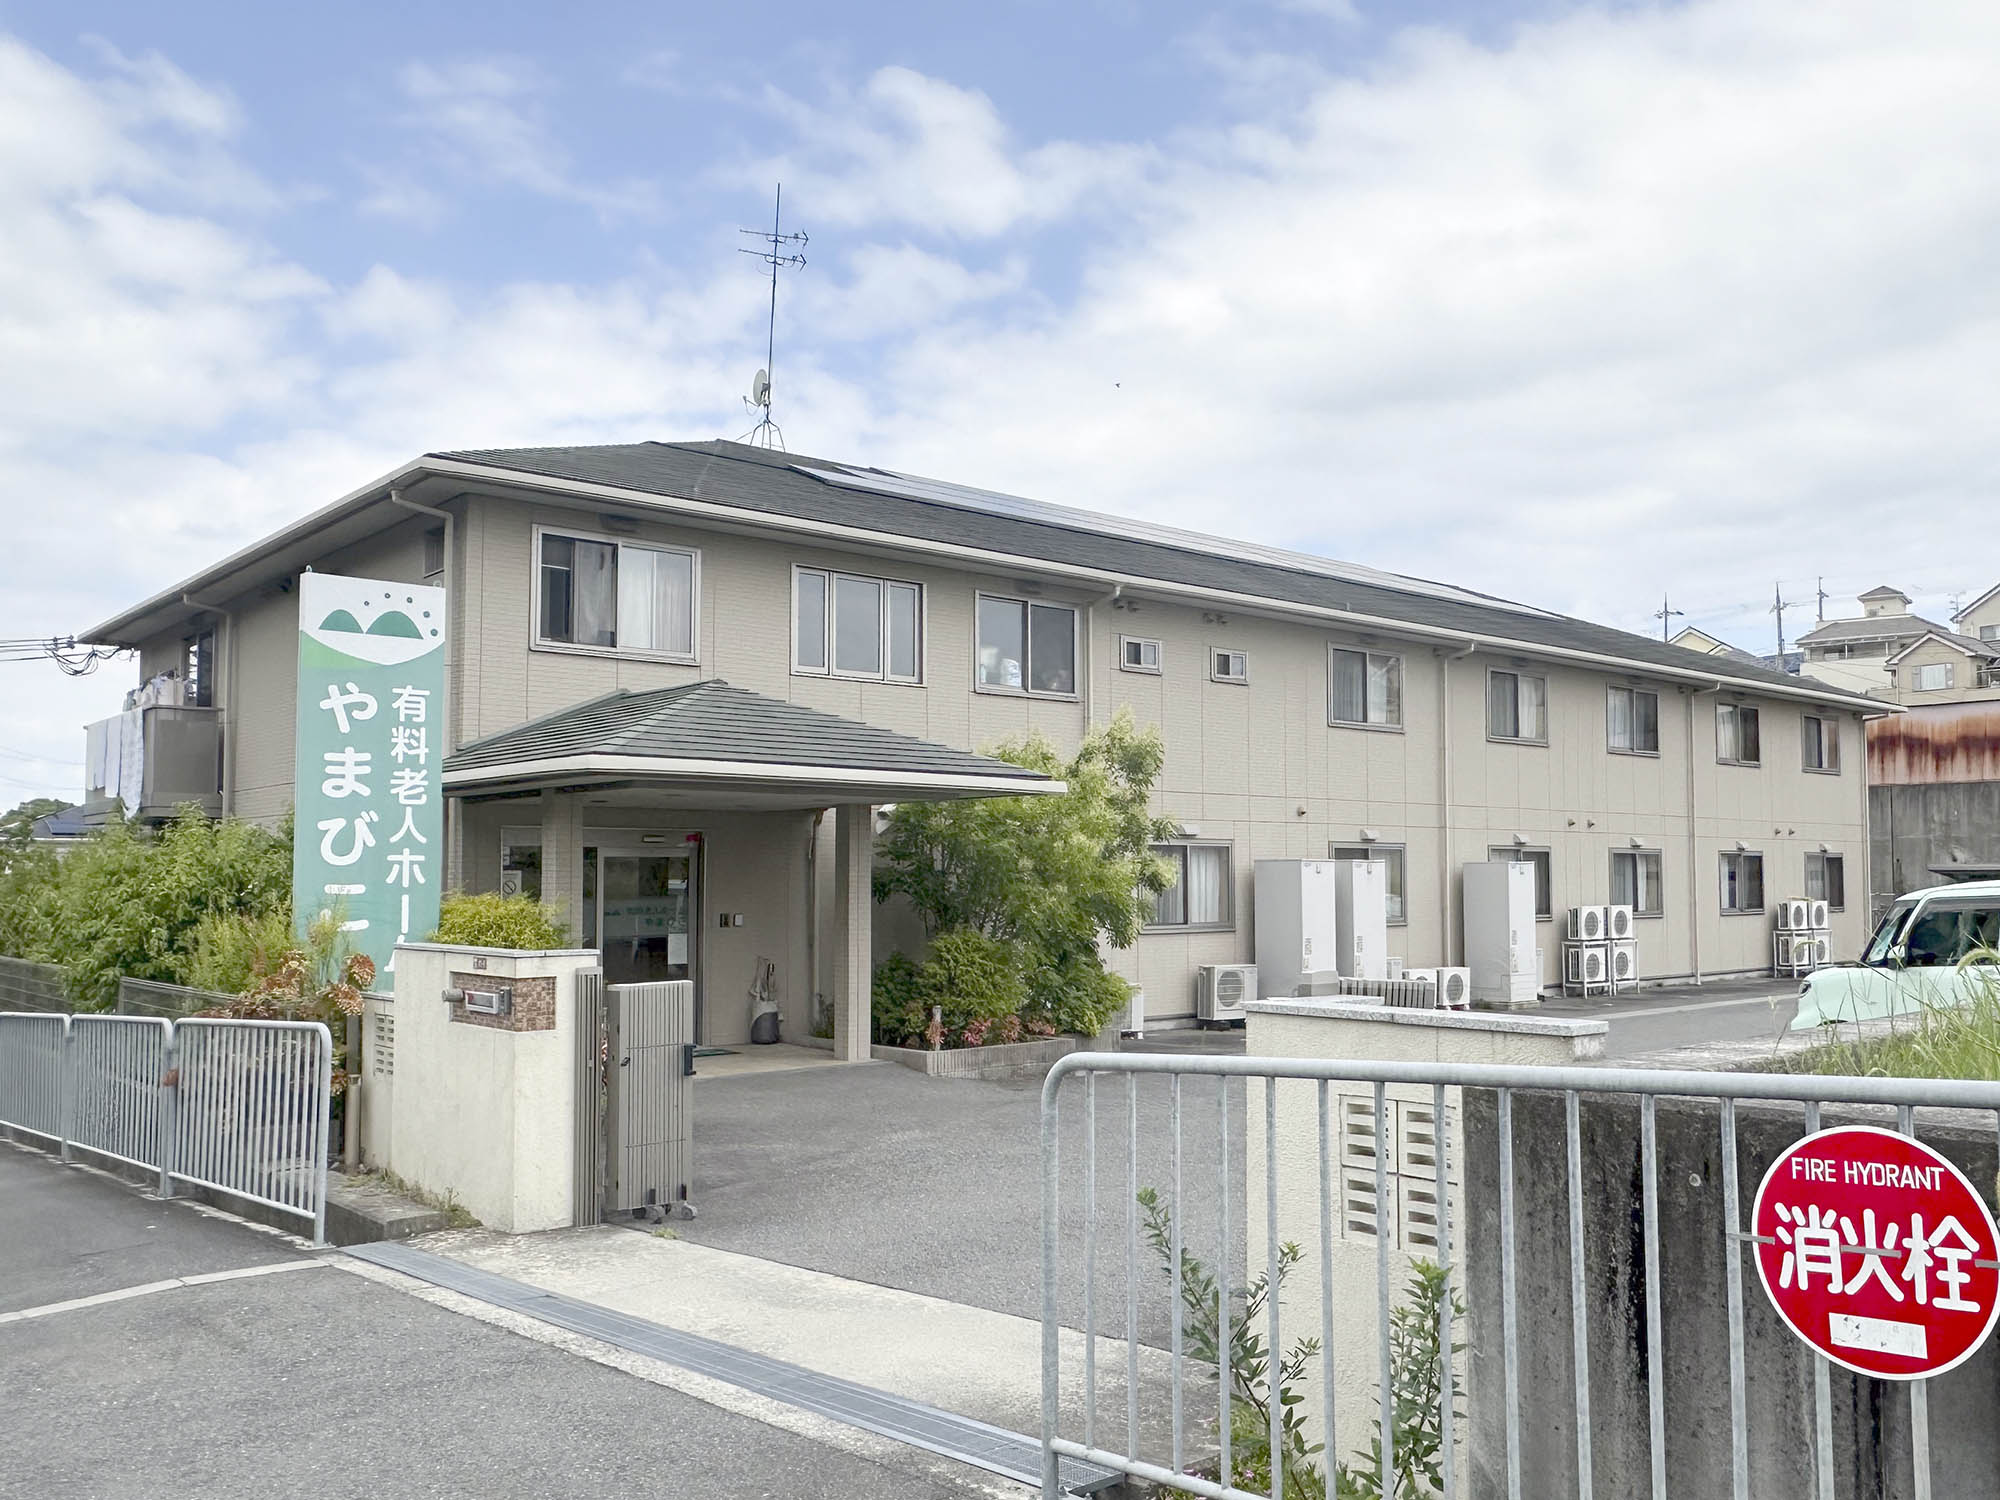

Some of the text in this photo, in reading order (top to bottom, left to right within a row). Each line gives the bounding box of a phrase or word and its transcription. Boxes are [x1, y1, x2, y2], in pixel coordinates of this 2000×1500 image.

[384, 684, 431, 972] 有料老人ホー
[1791, 1156, 1945, 1191] FIRE HYDRANT
[1774, 1202, 1981, 1313] 消火栓
